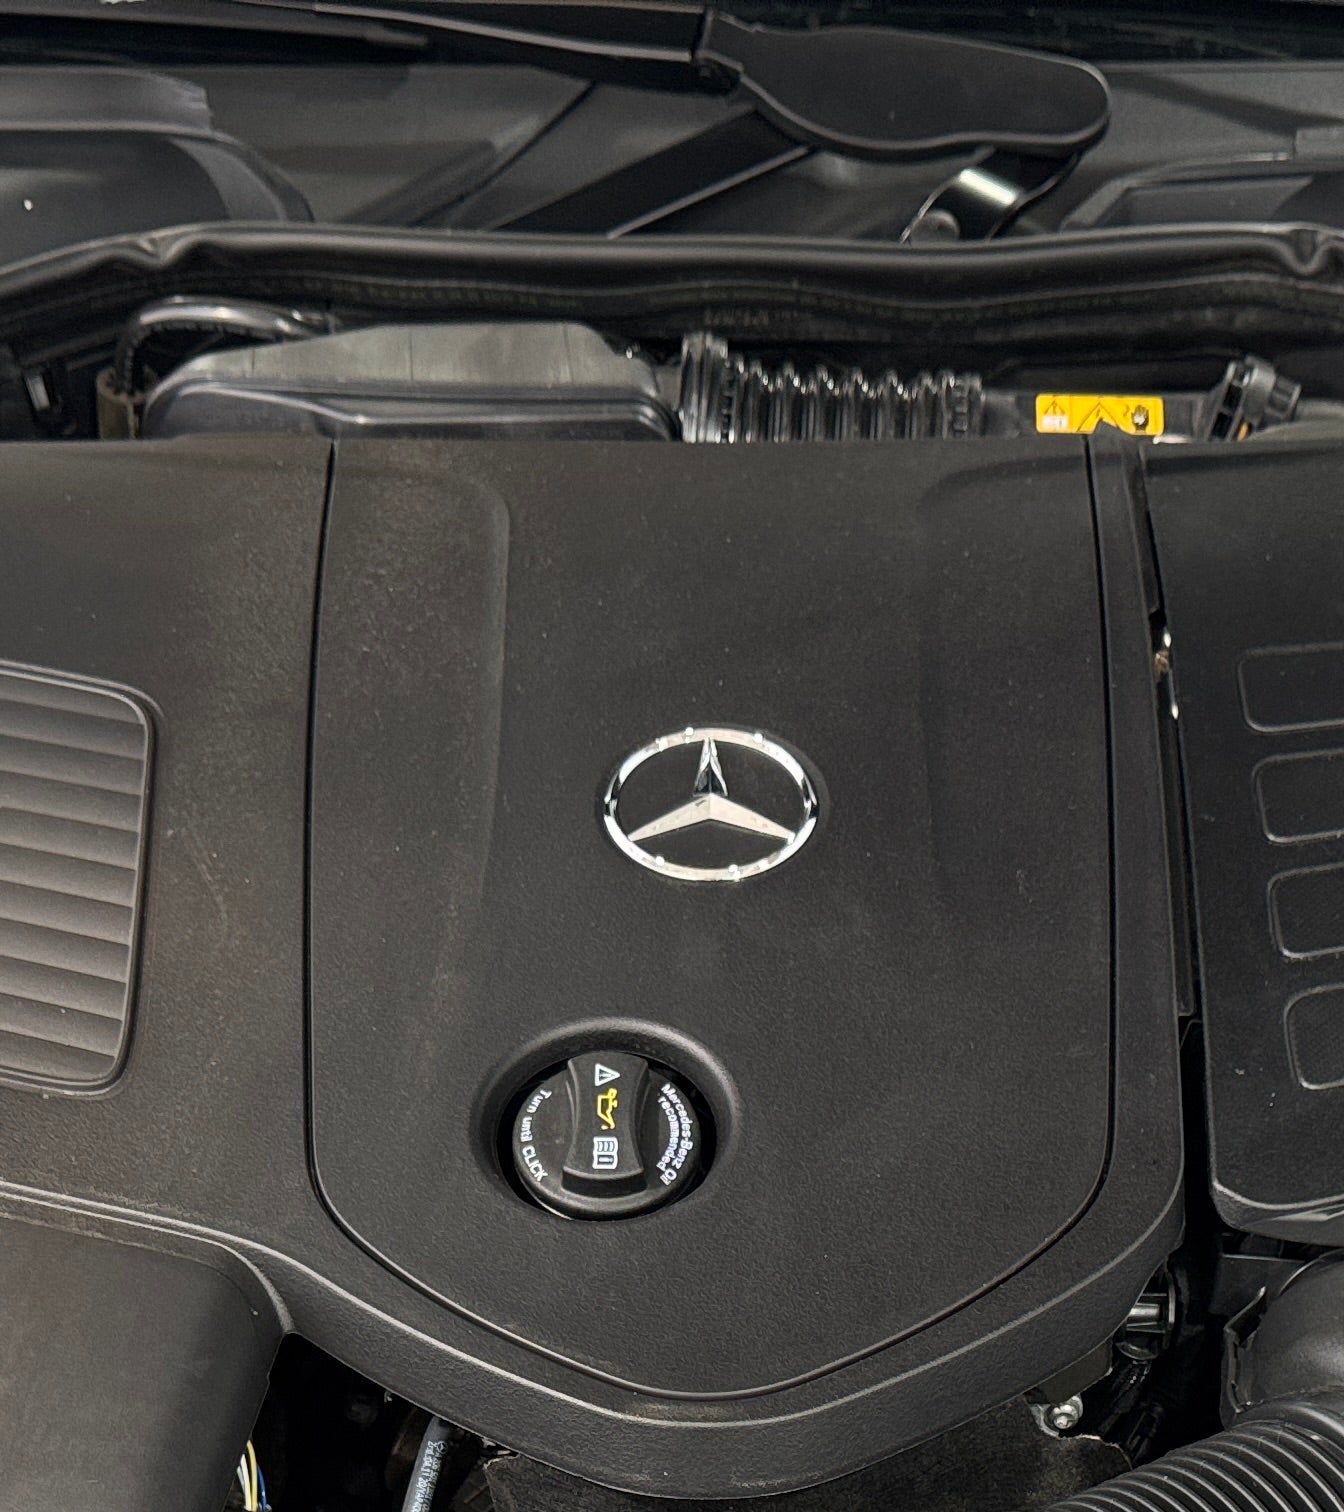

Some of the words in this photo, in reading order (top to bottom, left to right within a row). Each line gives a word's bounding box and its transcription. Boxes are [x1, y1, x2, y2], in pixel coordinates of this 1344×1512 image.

[526, 1088, 553, 1114] Turn
[660, 1083, 693, 1170] Mercedes-Benz
[656, 1096, 680, 1172] recommended
[522, 1145, 549, 1182] CLICK
